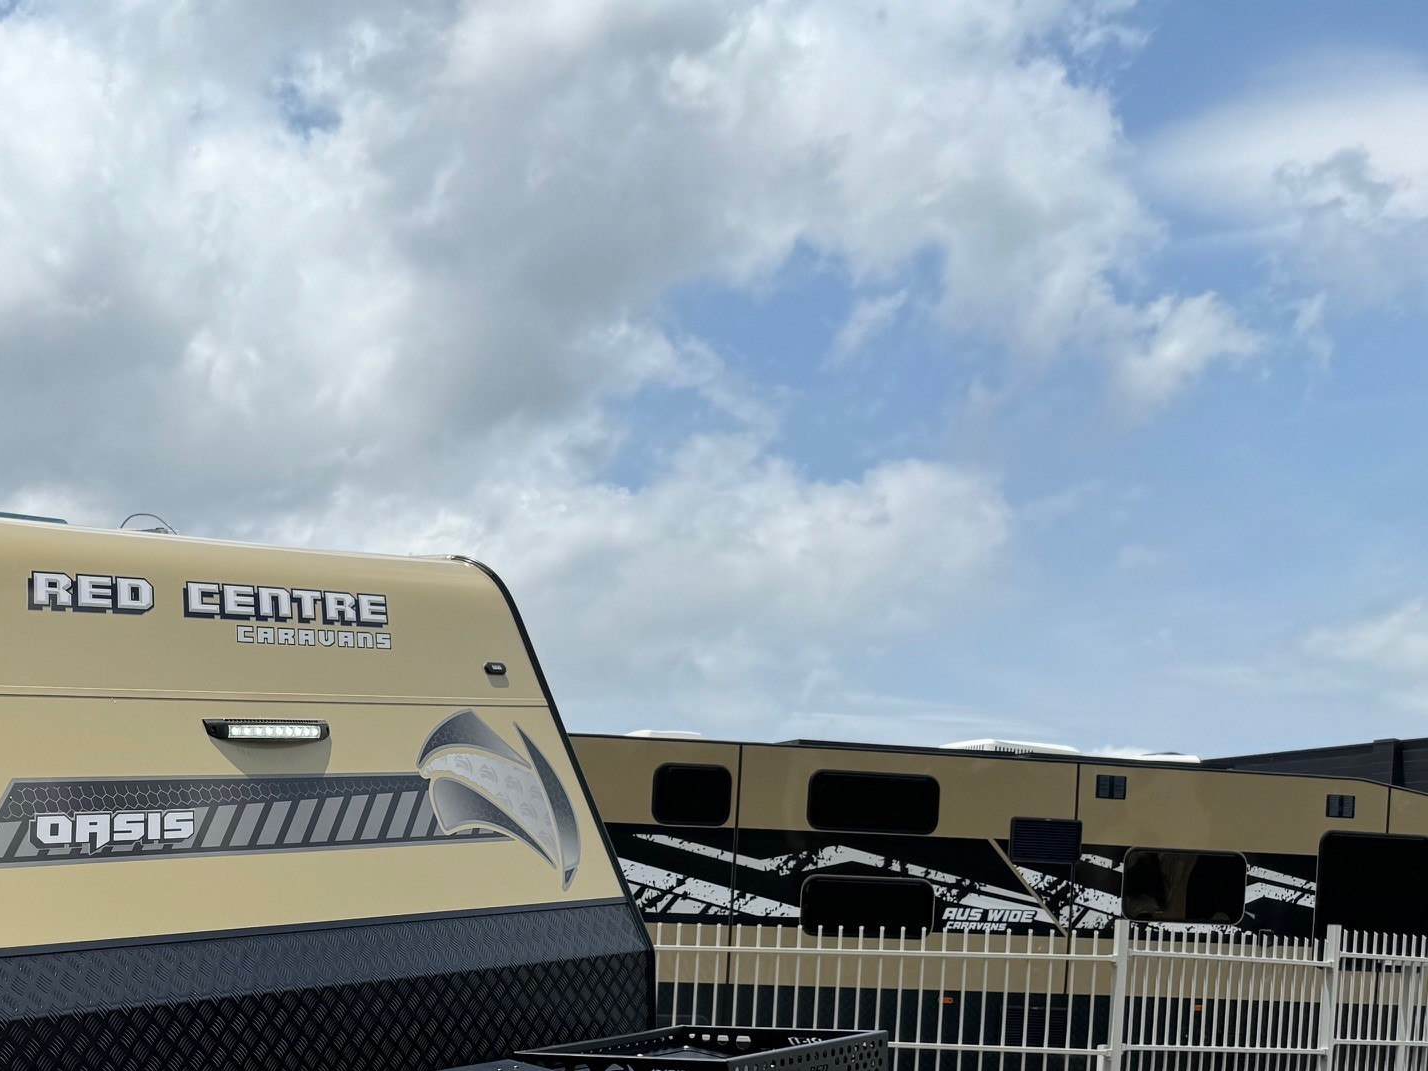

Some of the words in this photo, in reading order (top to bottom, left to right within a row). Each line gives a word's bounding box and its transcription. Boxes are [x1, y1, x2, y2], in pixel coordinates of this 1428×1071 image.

[28, 570, 154, 615] RED
[184, 581, 388, 626] CENTRE
[237, 625, 392, 650] CARAVANS
[30, 809, 195, 854] OASIS
[942, 907, 983, 921] AUS
[988, 909, 1037, 923] WIDE
[946, 921, 1007, 931] CARAVANS
